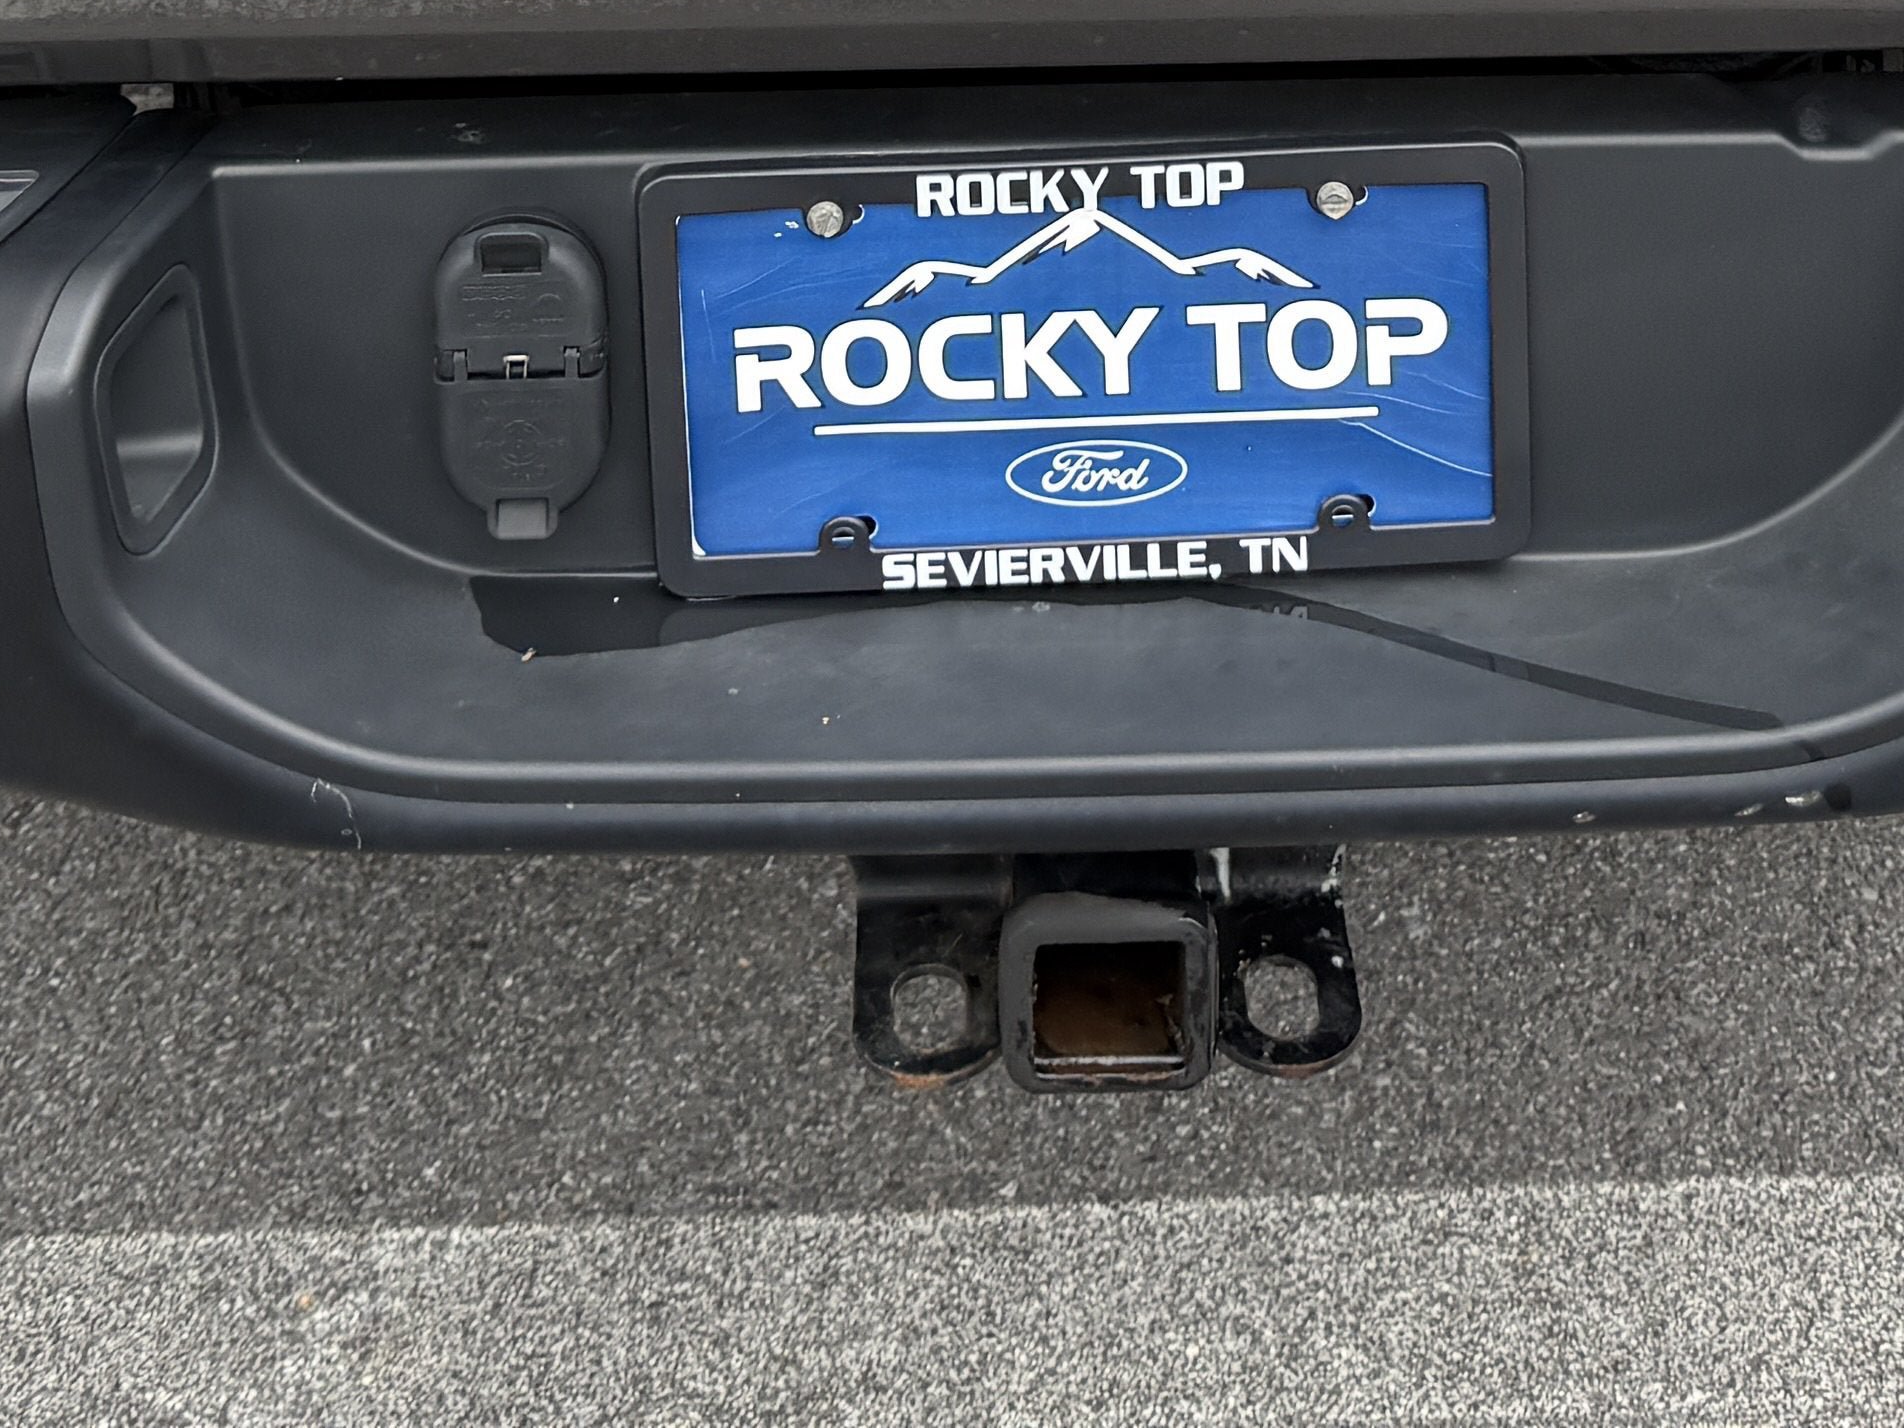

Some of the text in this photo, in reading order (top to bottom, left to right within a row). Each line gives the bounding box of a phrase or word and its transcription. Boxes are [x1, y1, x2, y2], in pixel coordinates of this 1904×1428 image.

[916, 160, 1245, 218] ROCKY TOP
[732, 297, 1449, 414] ROCKY TOP
[1040, 448, 1149, 494] Ford
[882, 535, 1309, 590] SEVIERVILLE, TN
